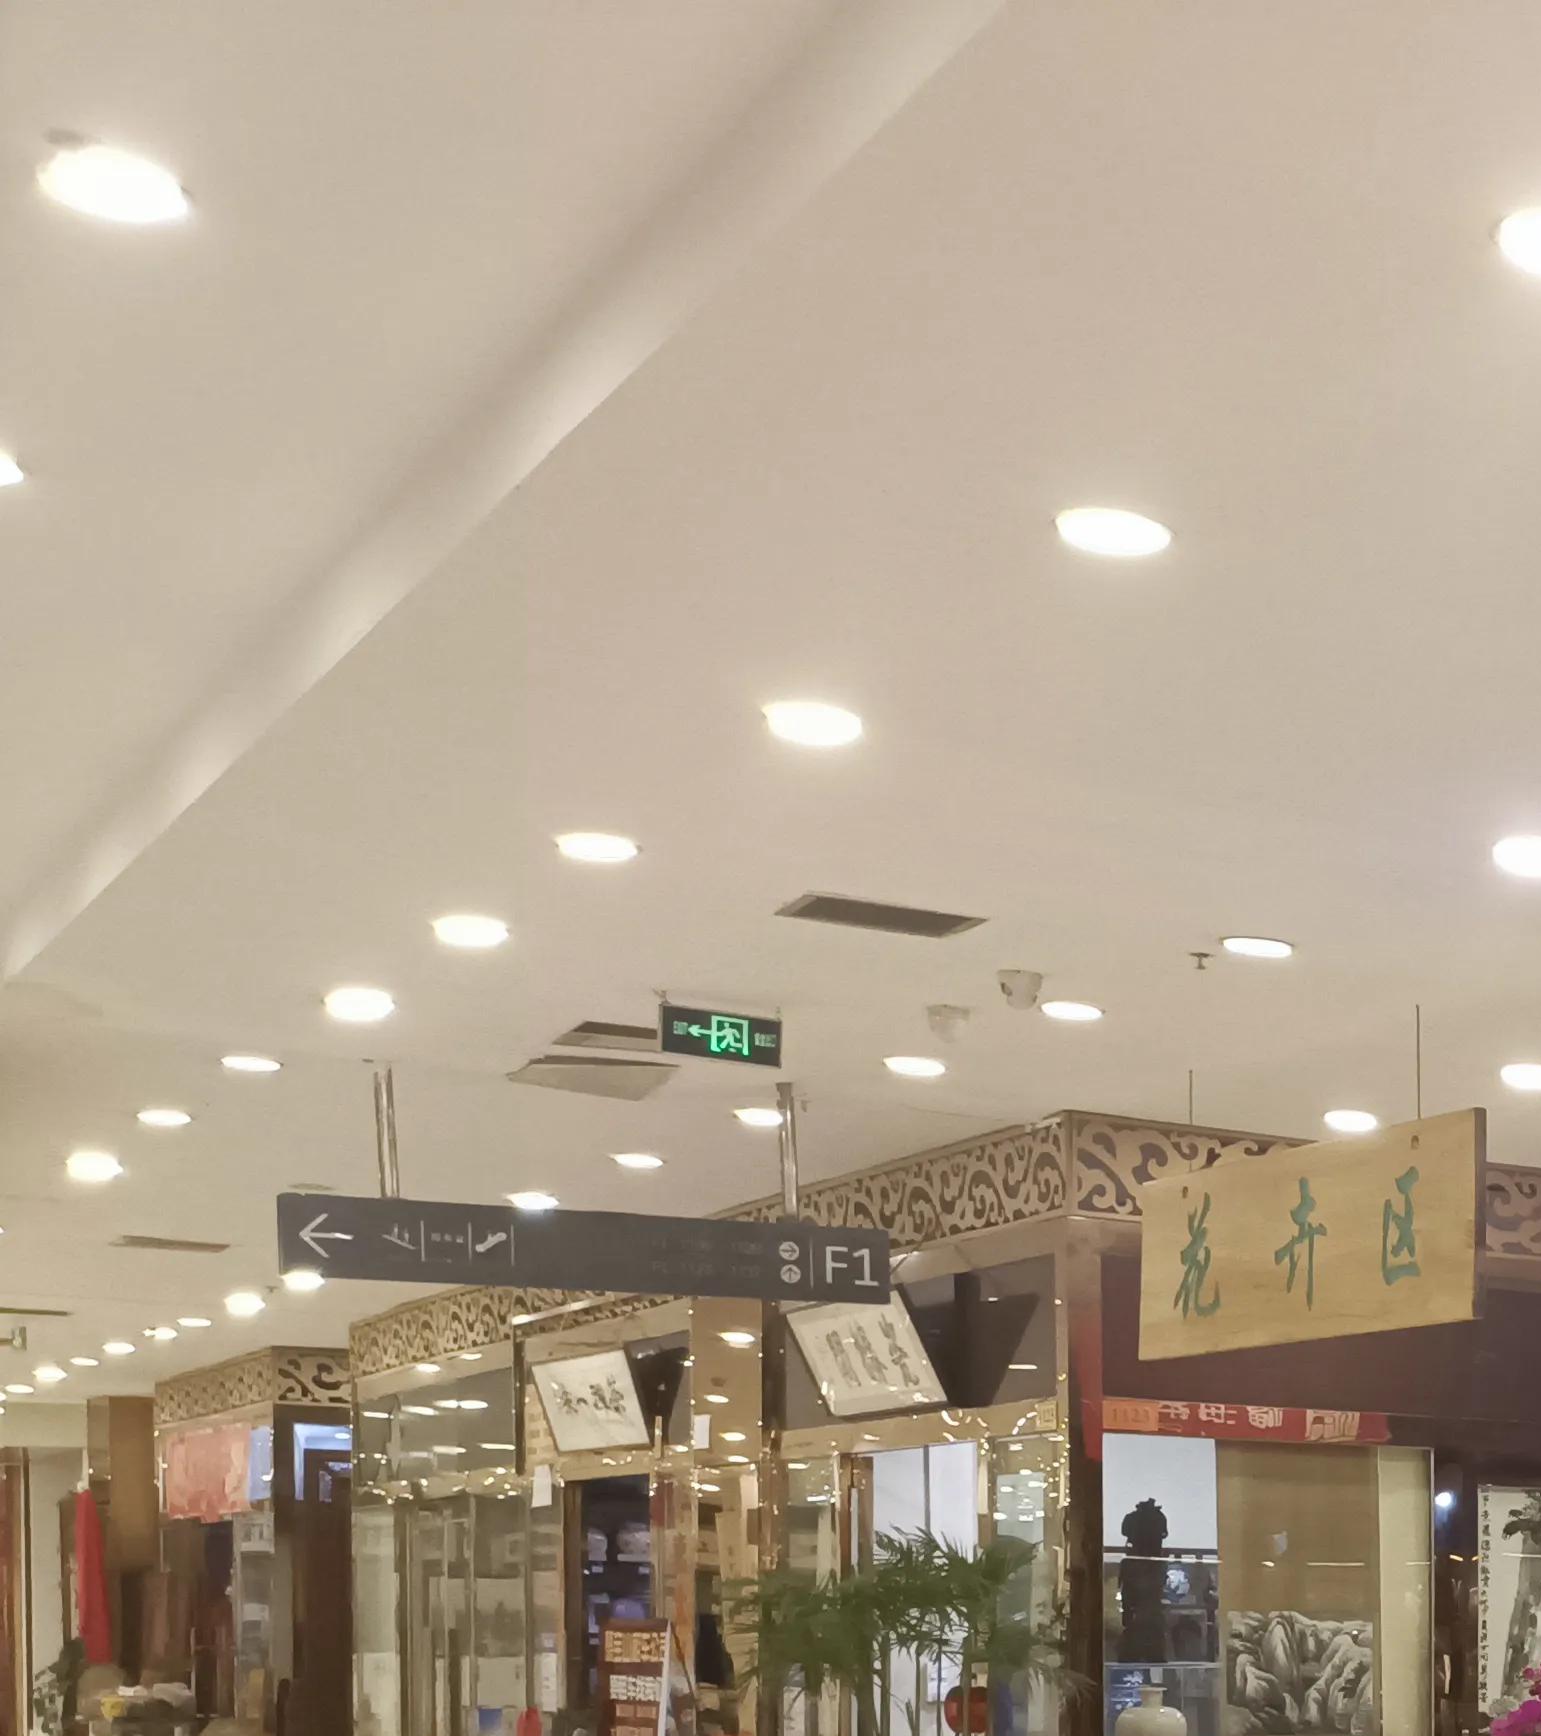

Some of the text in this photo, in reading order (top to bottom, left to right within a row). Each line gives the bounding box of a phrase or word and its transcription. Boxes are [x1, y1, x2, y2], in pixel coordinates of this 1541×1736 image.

[824, 1245, 880, 1287] F1
[1173, 1166, 1421, 1319] 花卉区
